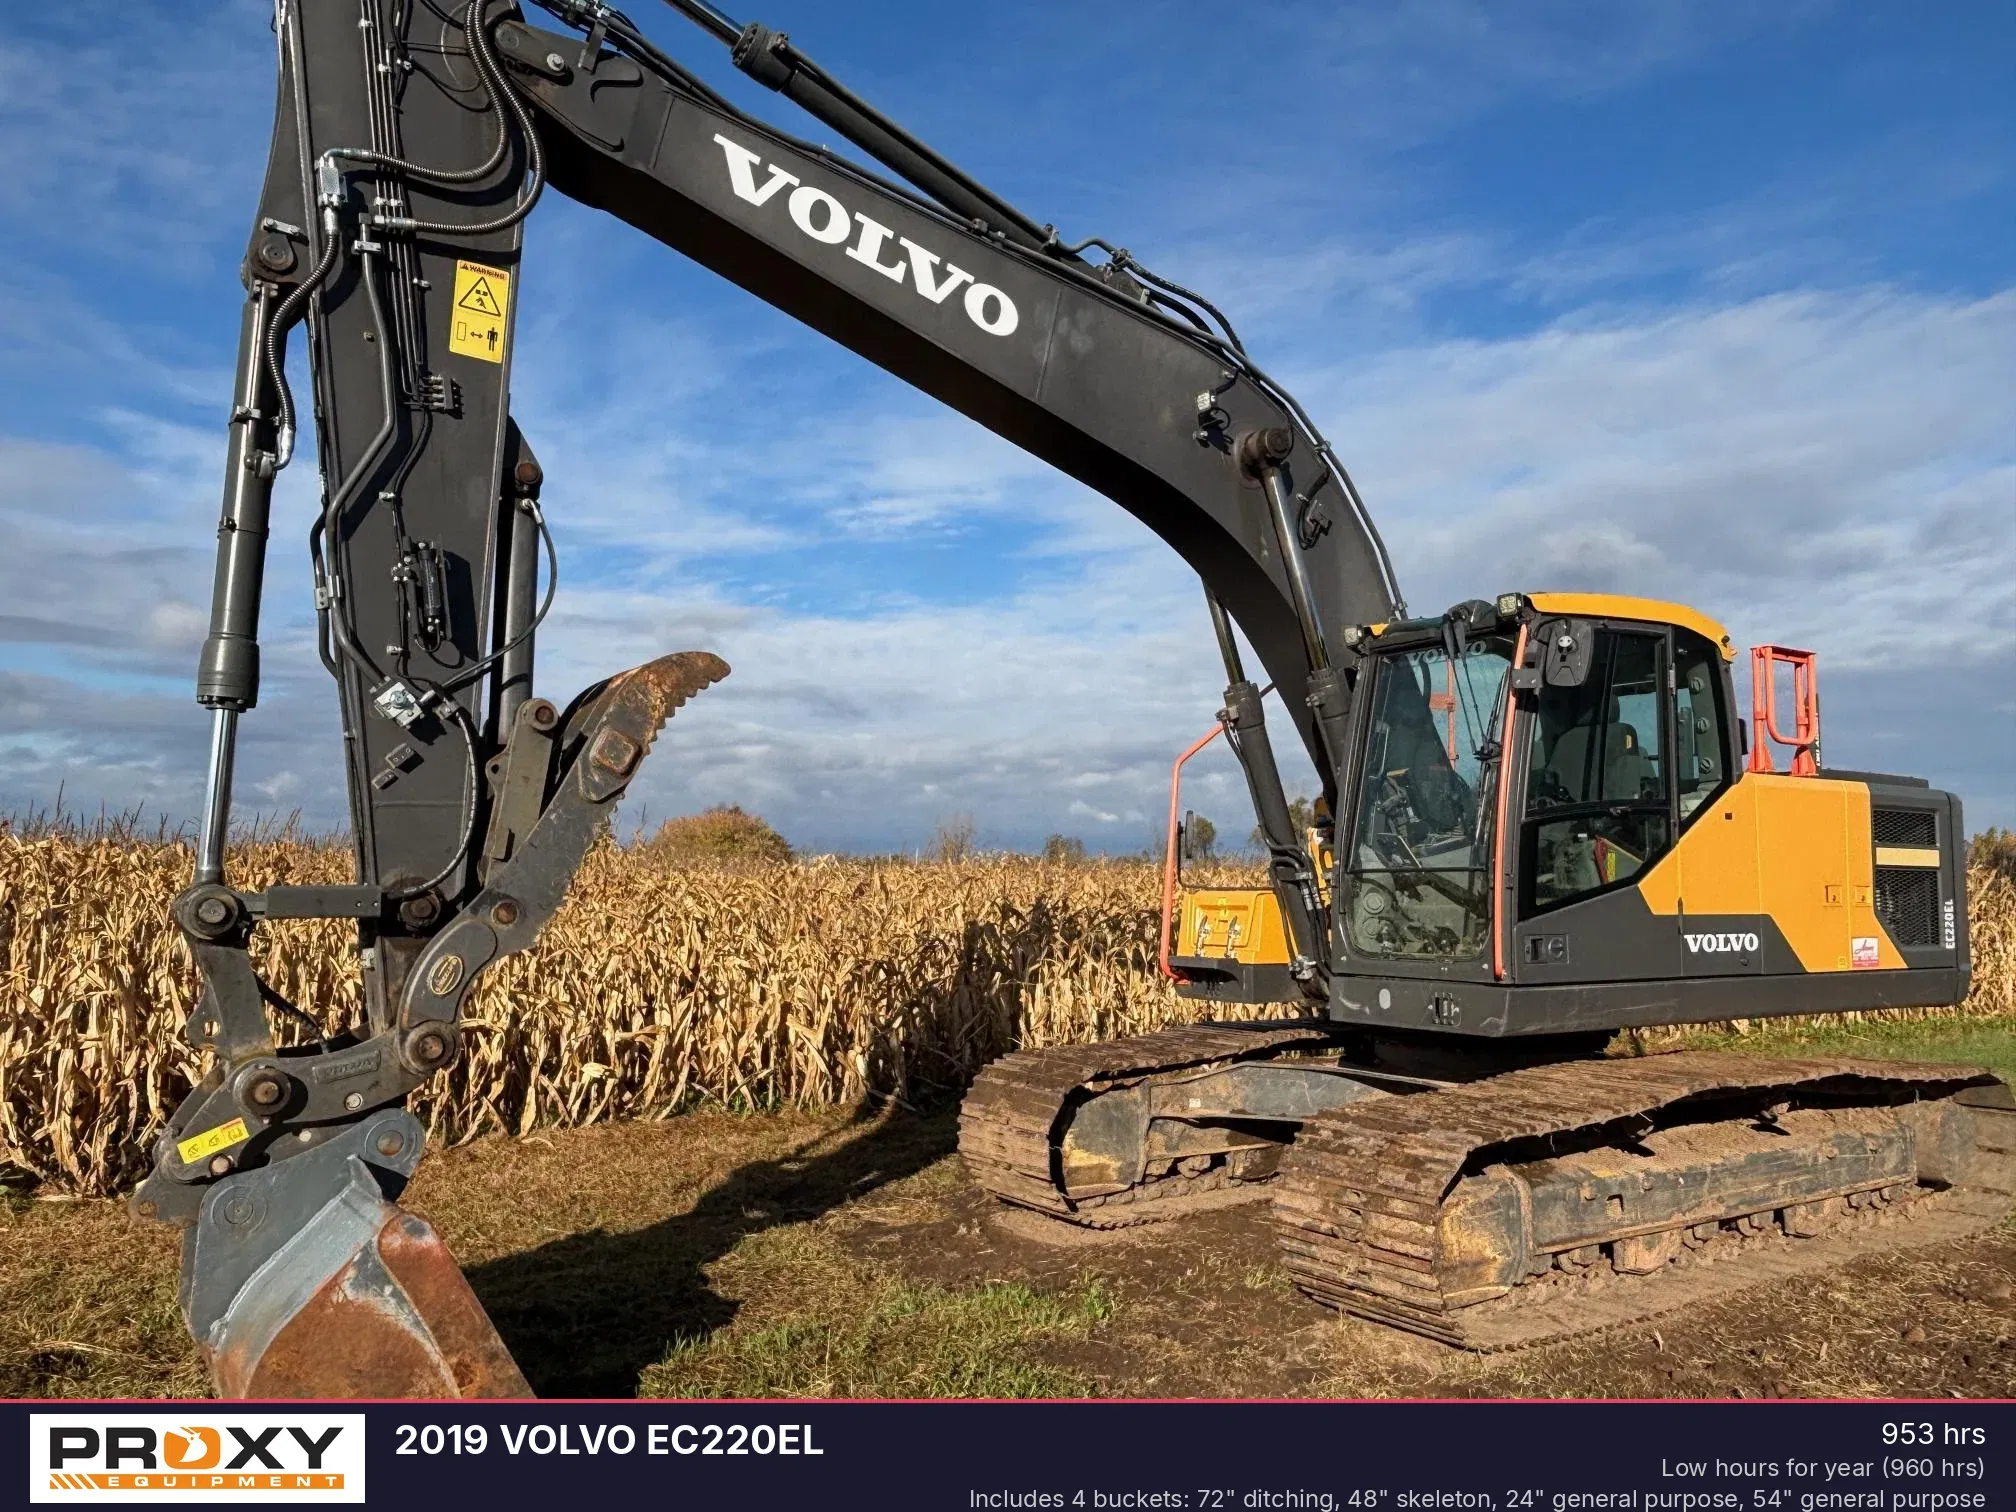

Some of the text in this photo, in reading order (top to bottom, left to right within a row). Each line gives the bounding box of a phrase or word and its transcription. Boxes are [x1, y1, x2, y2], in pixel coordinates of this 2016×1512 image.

[713, 133, 1019, 336] VOLVO
[1683, 932, 1759, 953] VOLVO
[1944, 898, 1955, 949] EC220EL
